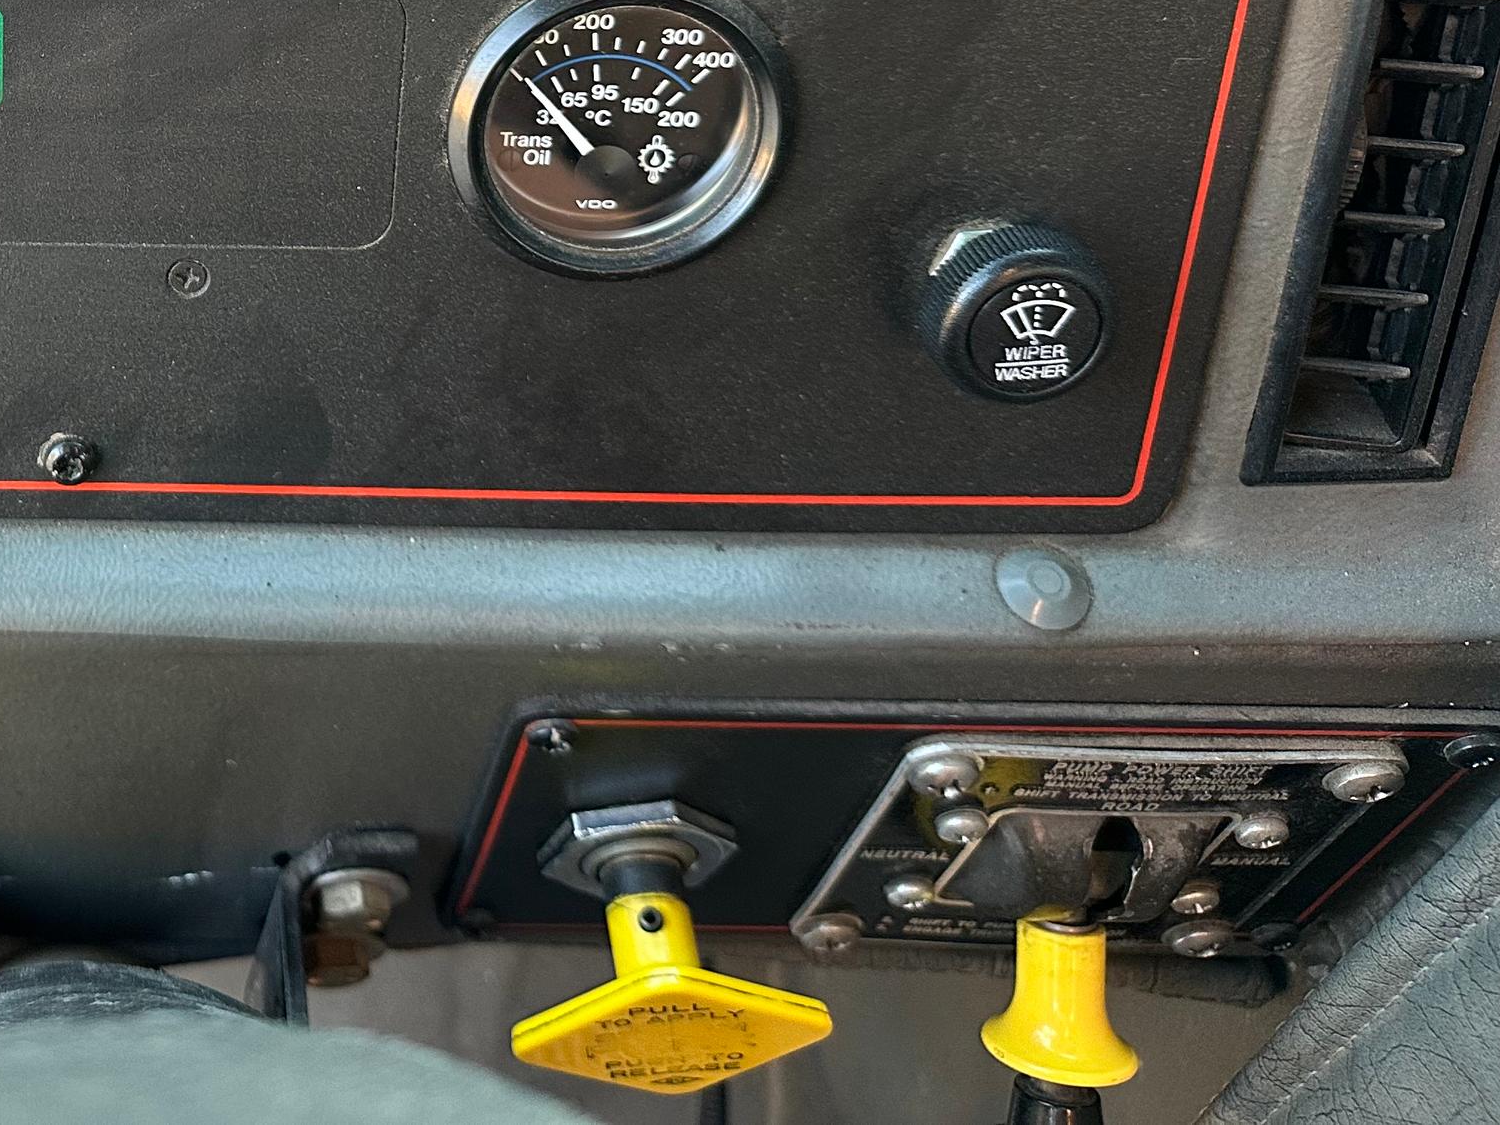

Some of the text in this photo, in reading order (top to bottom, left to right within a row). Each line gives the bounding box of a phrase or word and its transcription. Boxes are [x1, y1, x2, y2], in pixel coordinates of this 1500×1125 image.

[573, 14, 615, 31] 200
[661, 29, 704, 45] 300
[692, 51, 735, 68] 400
[561, 91, 588, 108] 65
[591, 85, 619, 101] 95
[621, 97, 659, 113] 150
[657, 111, 699, 128] 200
[500, 131, 552, 147] Trans
[522, 149, 550, 165] Oil
[575, 199, 618, 209] VDO
[1004, 344, 1067, 362] WIPER
[994, 363, 1068, 382] WASHER
[1052, 762, 1274, 777] PUMP POWER SHIFT
[1099, 802, 1160, 812] ROAD
[859, 848, 950, 861] NEUTRAL
[1209, 855, 1290, 866] MANUAL
[628, 1002, 711, 1017] PULL
[595, 1008, 746, 1029] TO APPLY
[707, 1051, 744, 1062] TO
[610, 1061, 742, 1079] RELEASE
